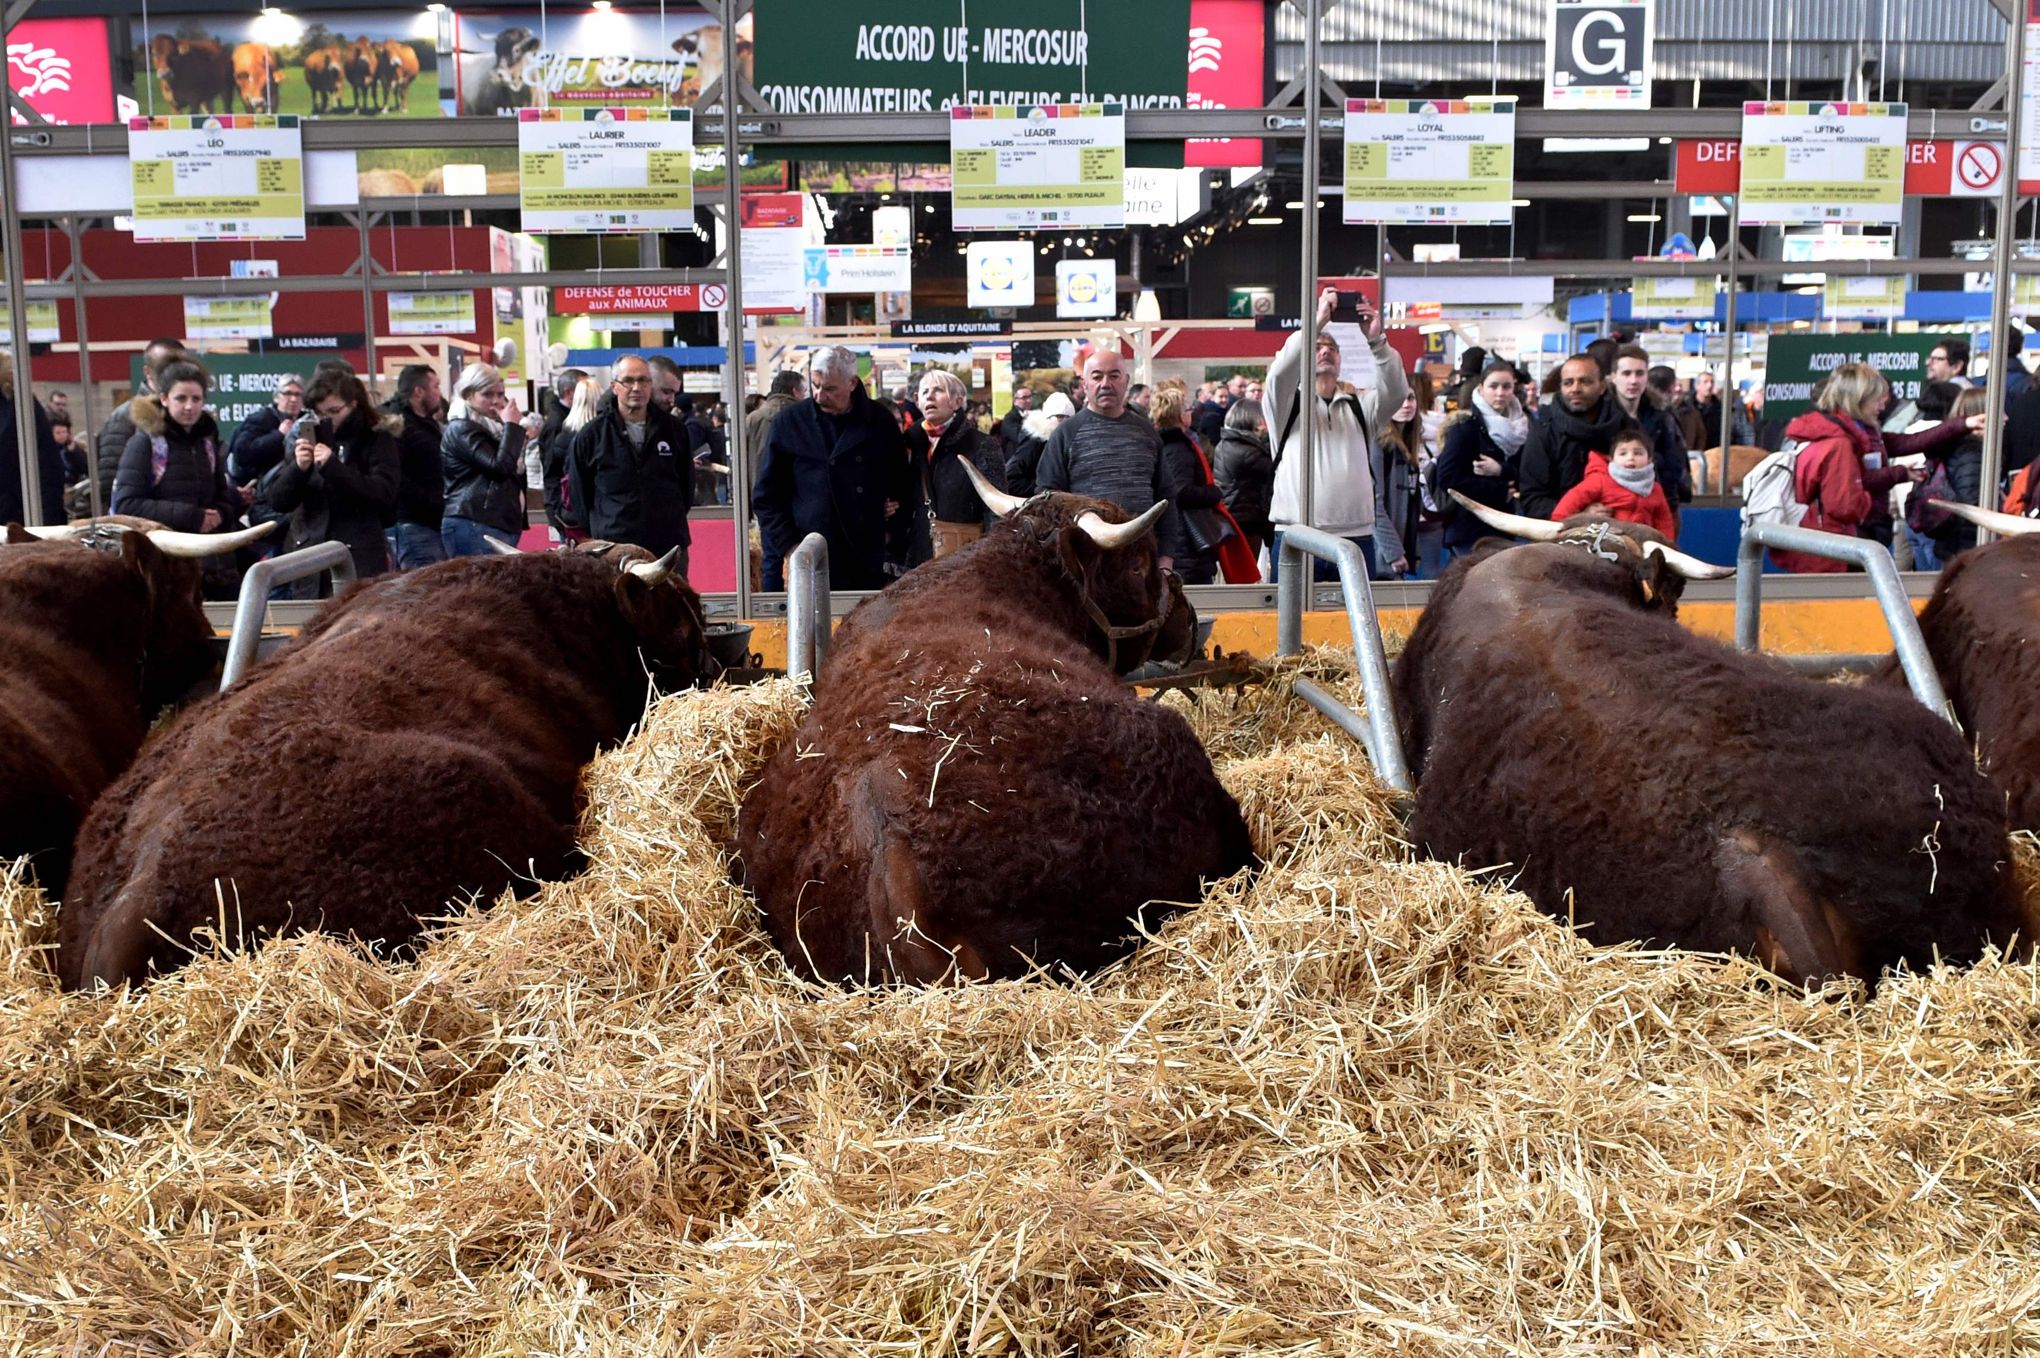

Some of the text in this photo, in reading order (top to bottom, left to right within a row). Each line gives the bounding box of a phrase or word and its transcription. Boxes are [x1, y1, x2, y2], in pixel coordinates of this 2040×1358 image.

[856, 24, 935, 61] ACCORD
[943, 27, 968, 62] UE
[983, 28, 1088, 65] MERCOSUR
[1572, 10, 1626, 75] G
[1024, 129, 1056, 137] LEADER
[1417, 124, 1444, 132] LOYAL
[1814, 126, 1845, 134] LIFTING
[589, 131, 625, 139] LAURIER
[208, 140, 224, 148] LEO
[1696, 142, 1738, 162] DEF
[565, 286, 691, 298] DEFENSE de TOUCHER
[588, 298, 668, 309] aux ANIMAUX
[902, 323, 1000, 333] LA BLONDE D'AQUITAINE
[279, 338, 290, 347] LA
[1809, 353, 1846, 370] ACCORD
[1867, 352, 1919, 370] MERCOSUR
[219, 374, 233, 392] UE
[239, 374, 280, 392] MERCOS
[1907, 381, 1921, 398] EN
[220, 405, 231, 422] et
